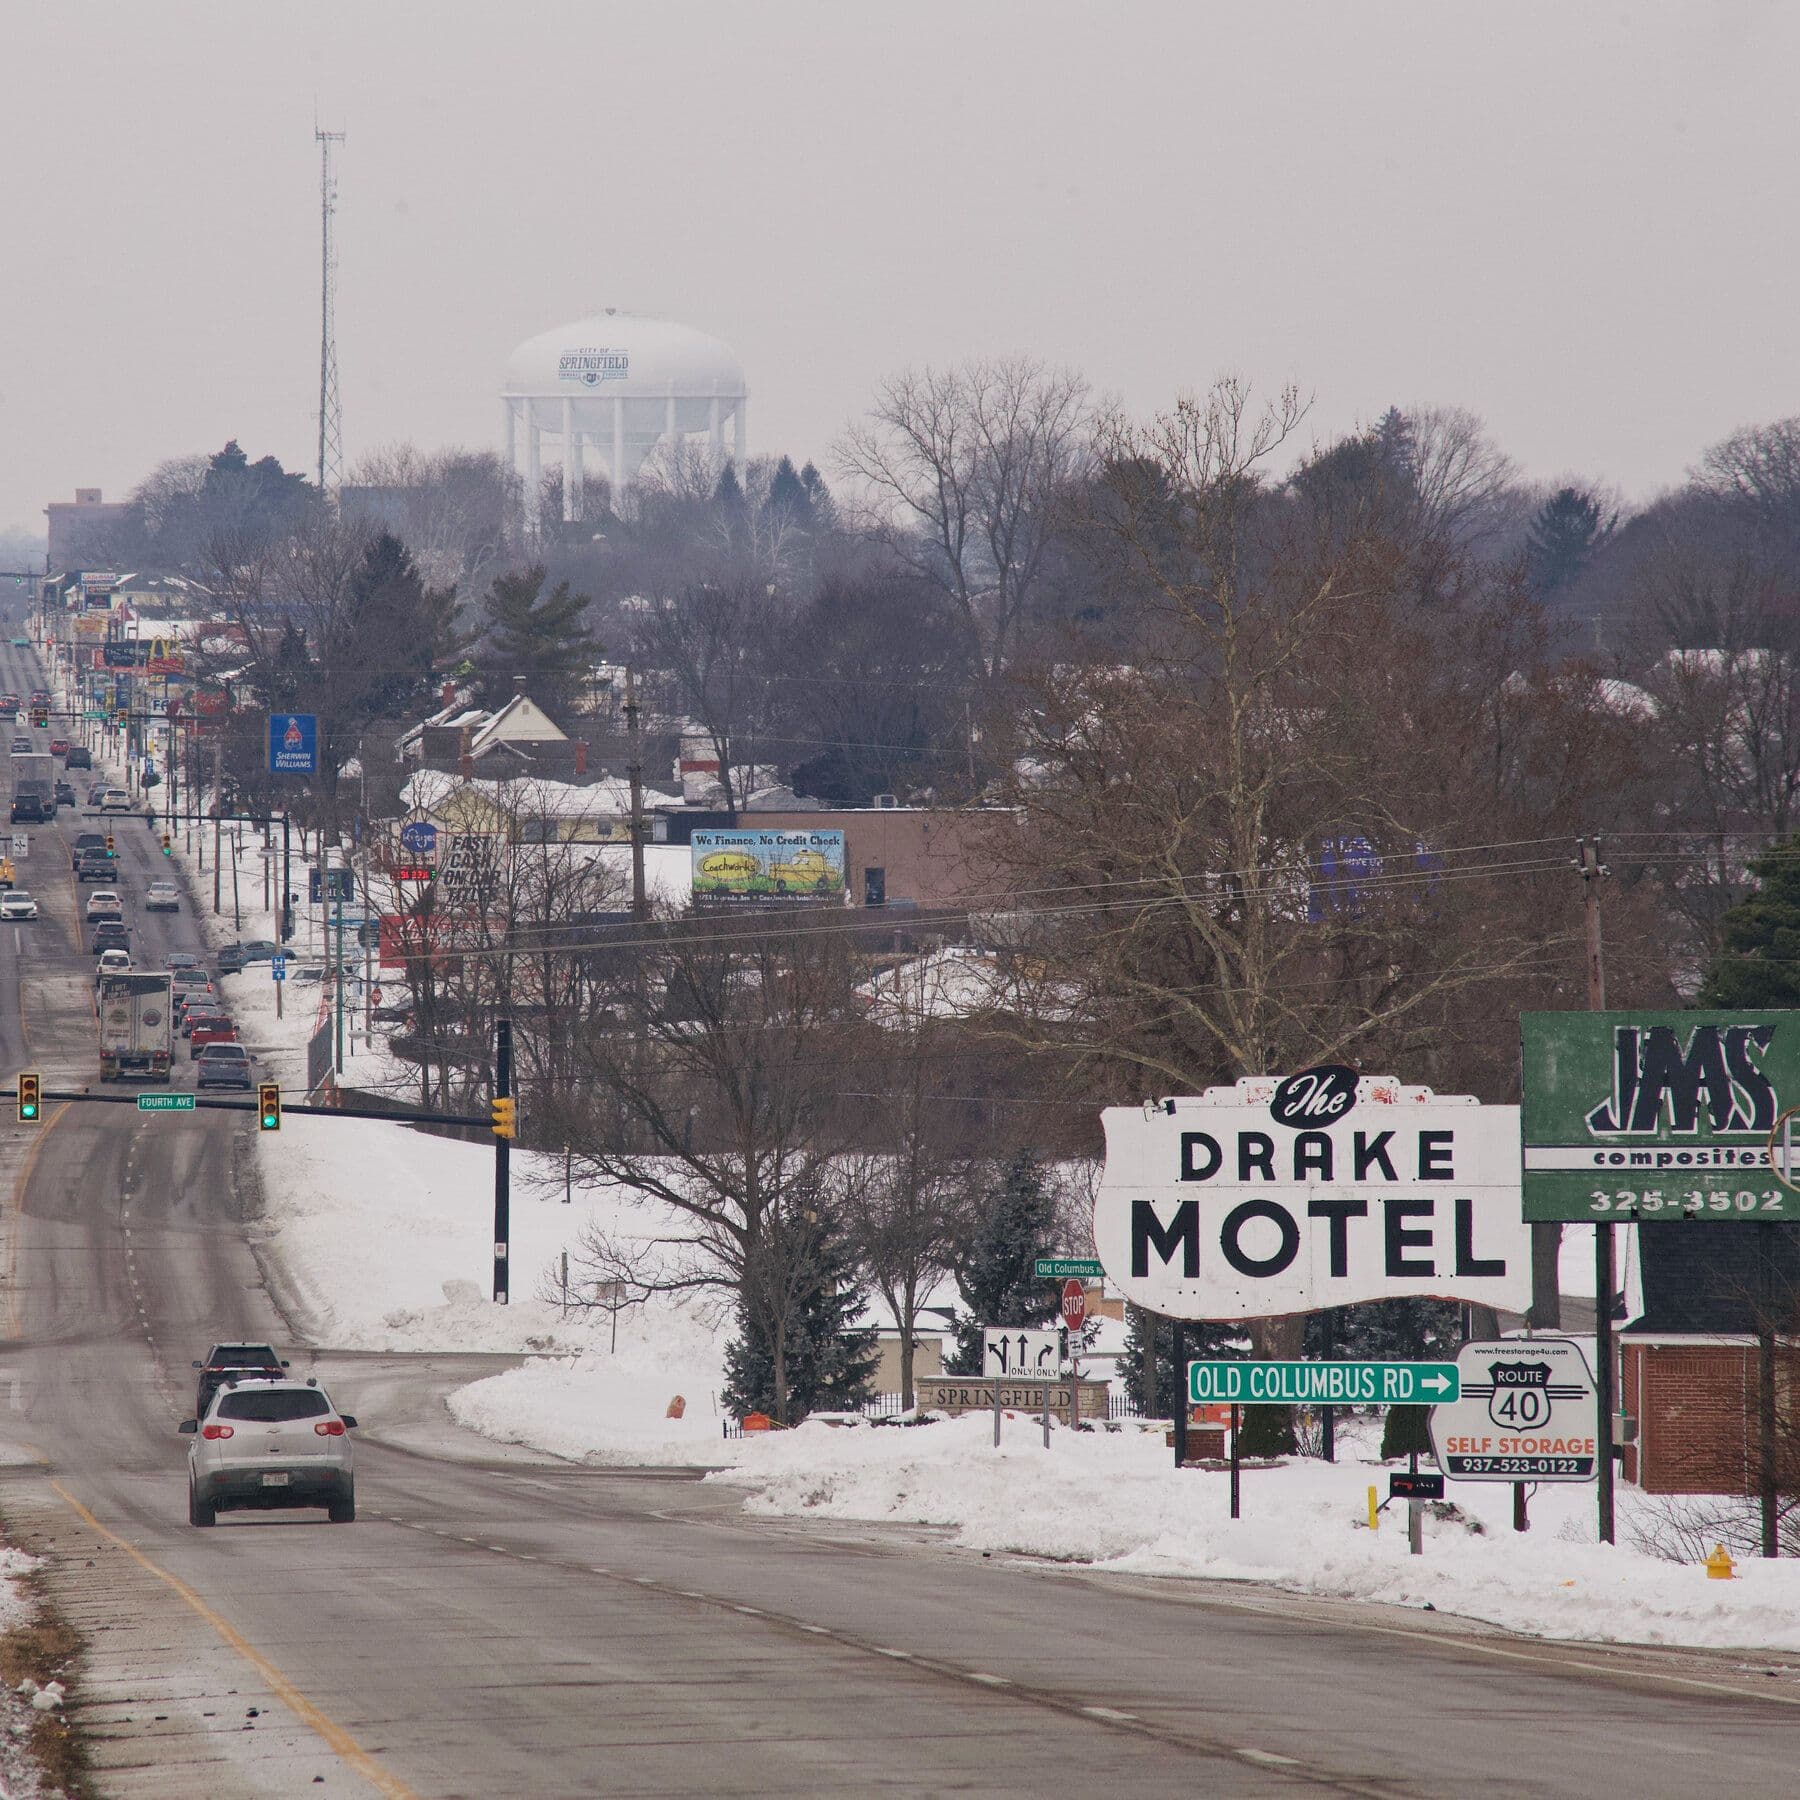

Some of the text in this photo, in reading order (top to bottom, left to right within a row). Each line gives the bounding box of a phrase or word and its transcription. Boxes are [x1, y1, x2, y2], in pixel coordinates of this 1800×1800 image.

[559, 357, 628, 369] SPRINGFIELD
[276, 752, 311, 760] SHERWIN
[452, 836, 490, 852] FAST
[696, 835, 840, 846] We Finance, No Credit Check
[1585, 1025, 1777, 1134] JMS
[141, 1097, 192, 1107] FOURTH AVE
[1284, 1074, 1348, 1117] The
[1181, 1131, 1454, 1181] DRAKE
[1593, 1149, 1771, 1167] composites
[1590, 1191, 1783, 1211] 325-3502
[1132, 1199, 1506, 1278] MOTEL
[1038, 1263, 1052, 1274] Old
[1054, 1263, 1095, 1274] Columbus
[1064, 1295, 1084, 1316] STOP
[1474, 1348, 1568, 1356] www.freestorage4u.com
[1011, 1367, 1033, 1376] ONLY
[1036, 1368, 1058, 1377] ONLY
[1497, 1371, 1543, 1383] ROUTE
[1197, 1367, 1414, 1399] OLD COLUMBUS RD
[937, 1388, 1072, 1407] SPRINGFIELD
[1498, 1391, 1540, 1422] 40
[1446, 1437, 1595, 1455] SELF STORAGE
[1462, 1458, 1578, 1473] 937-523-0122
